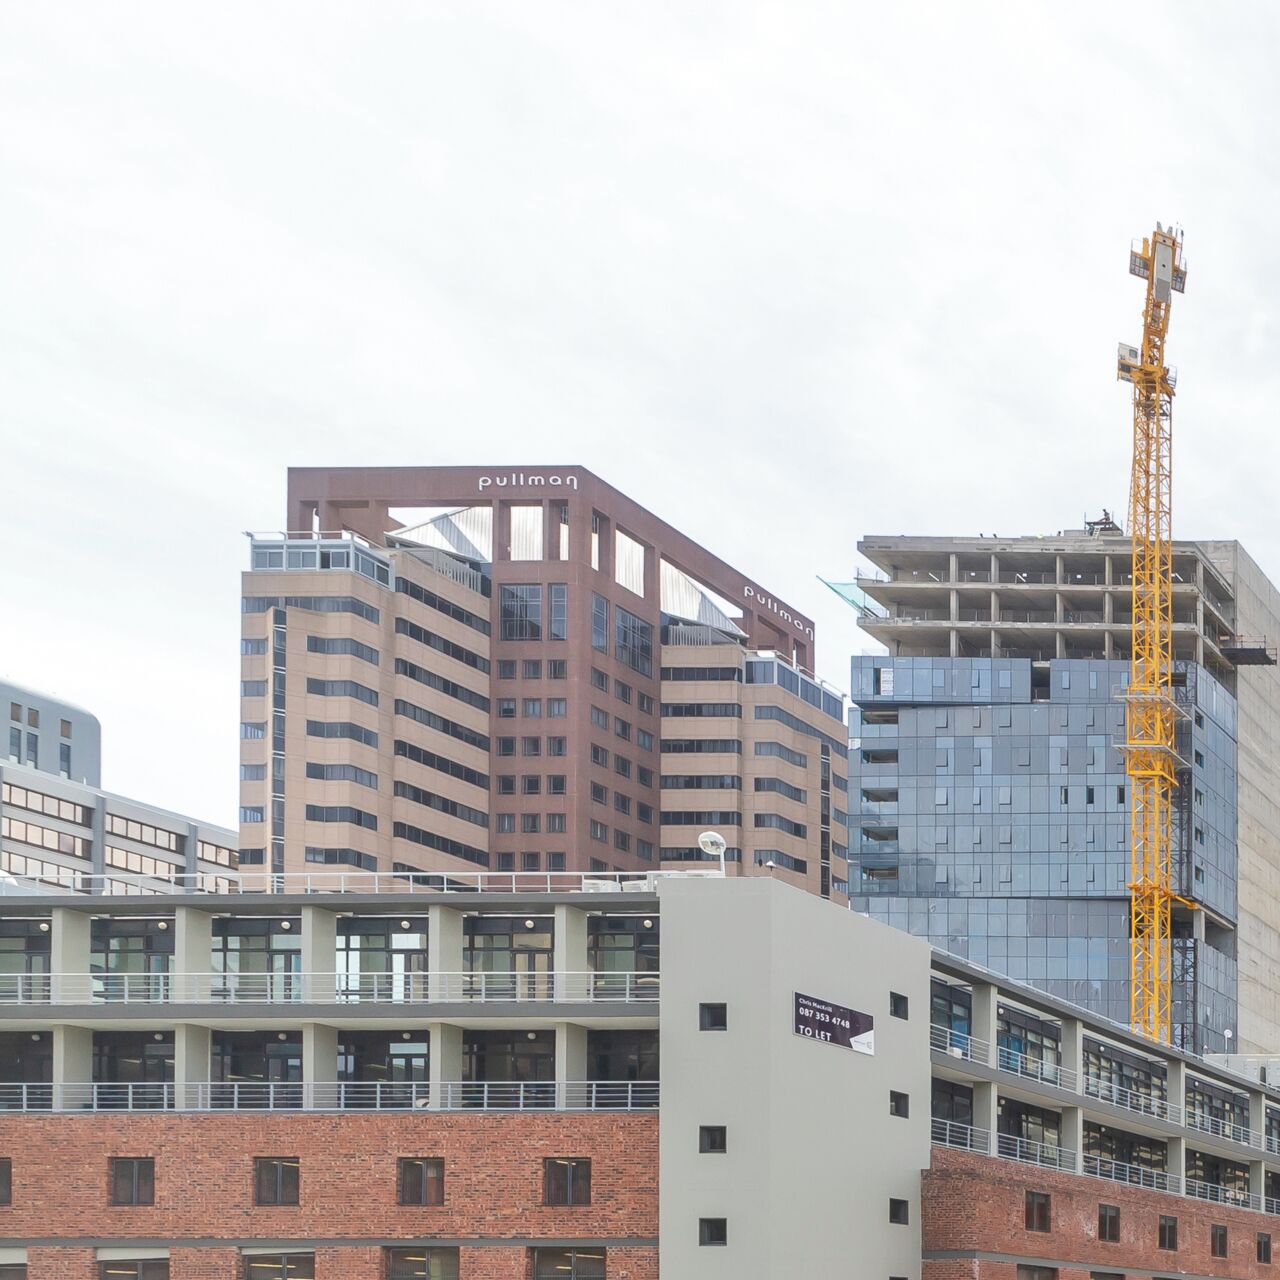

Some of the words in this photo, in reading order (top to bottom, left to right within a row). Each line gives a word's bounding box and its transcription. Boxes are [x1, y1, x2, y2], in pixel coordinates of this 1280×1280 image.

[478, 472, 578, 491] pullman
[744, 586, 814, 641] pullman
[799, 997, 812, 1007] Chris
[799, 1007, 813, 1018] 087
[815, 1012, 830, 1023] 353
[831, 1017, 850, 1029] 4748
[798, 1024, 812, 1037] TO
[815, 1029, 832, 1042] LET
